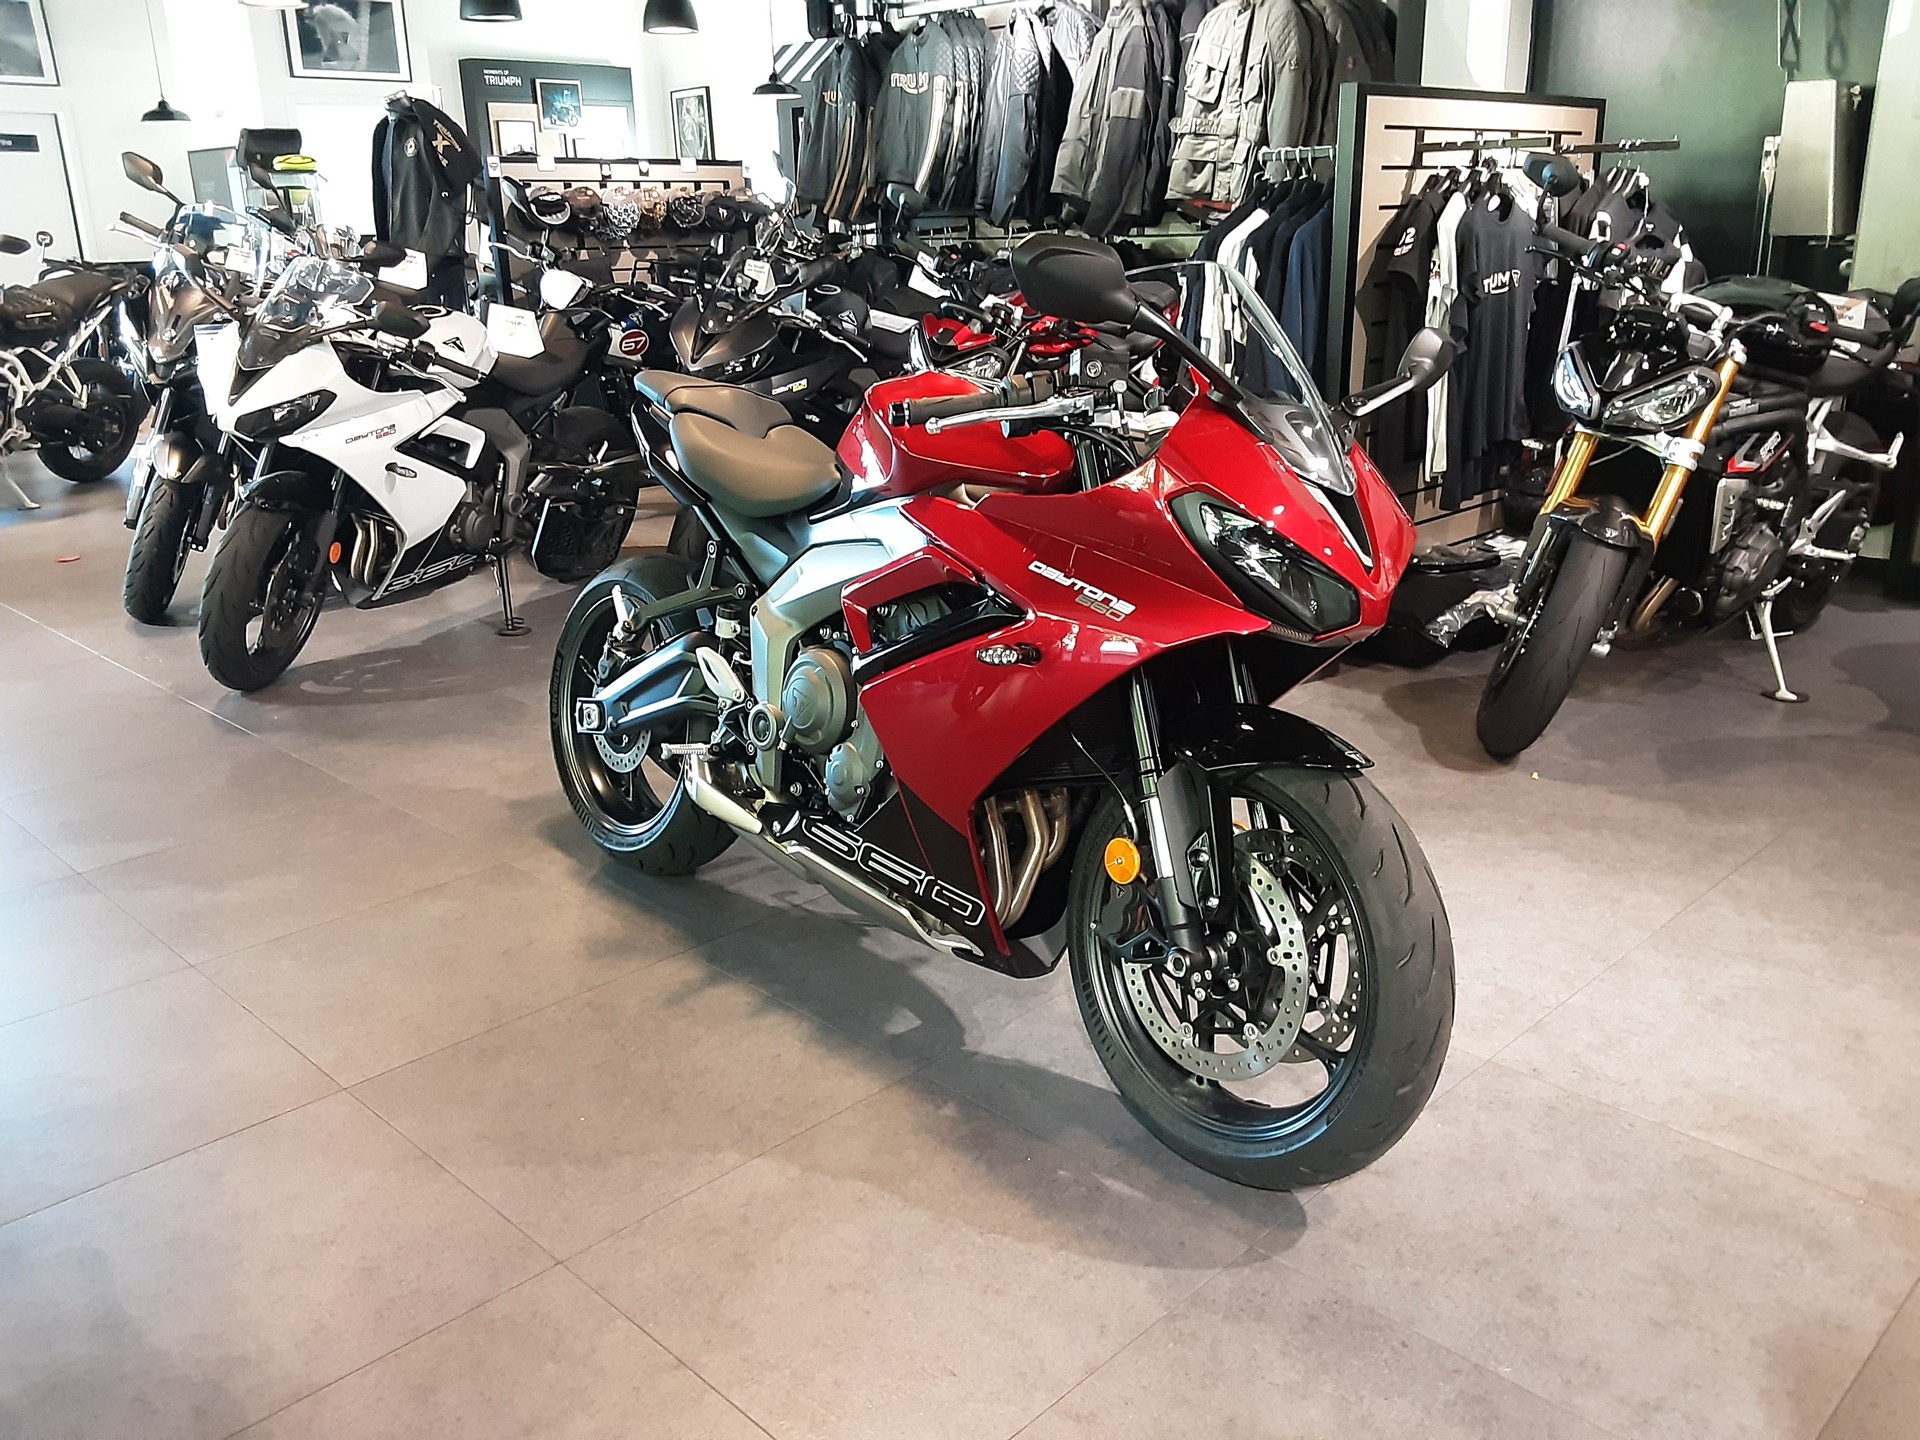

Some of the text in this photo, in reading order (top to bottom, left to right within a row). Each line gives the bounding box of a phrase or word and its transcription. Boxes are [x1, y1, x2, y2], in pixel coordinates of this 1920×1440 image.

[483, 75, 522, 86] TRIUMPH
[622, 337, 646, 351] 67
[1028, 560, 1136, 615] DAYTONA
[1075, 594, 1126, 622] 660
